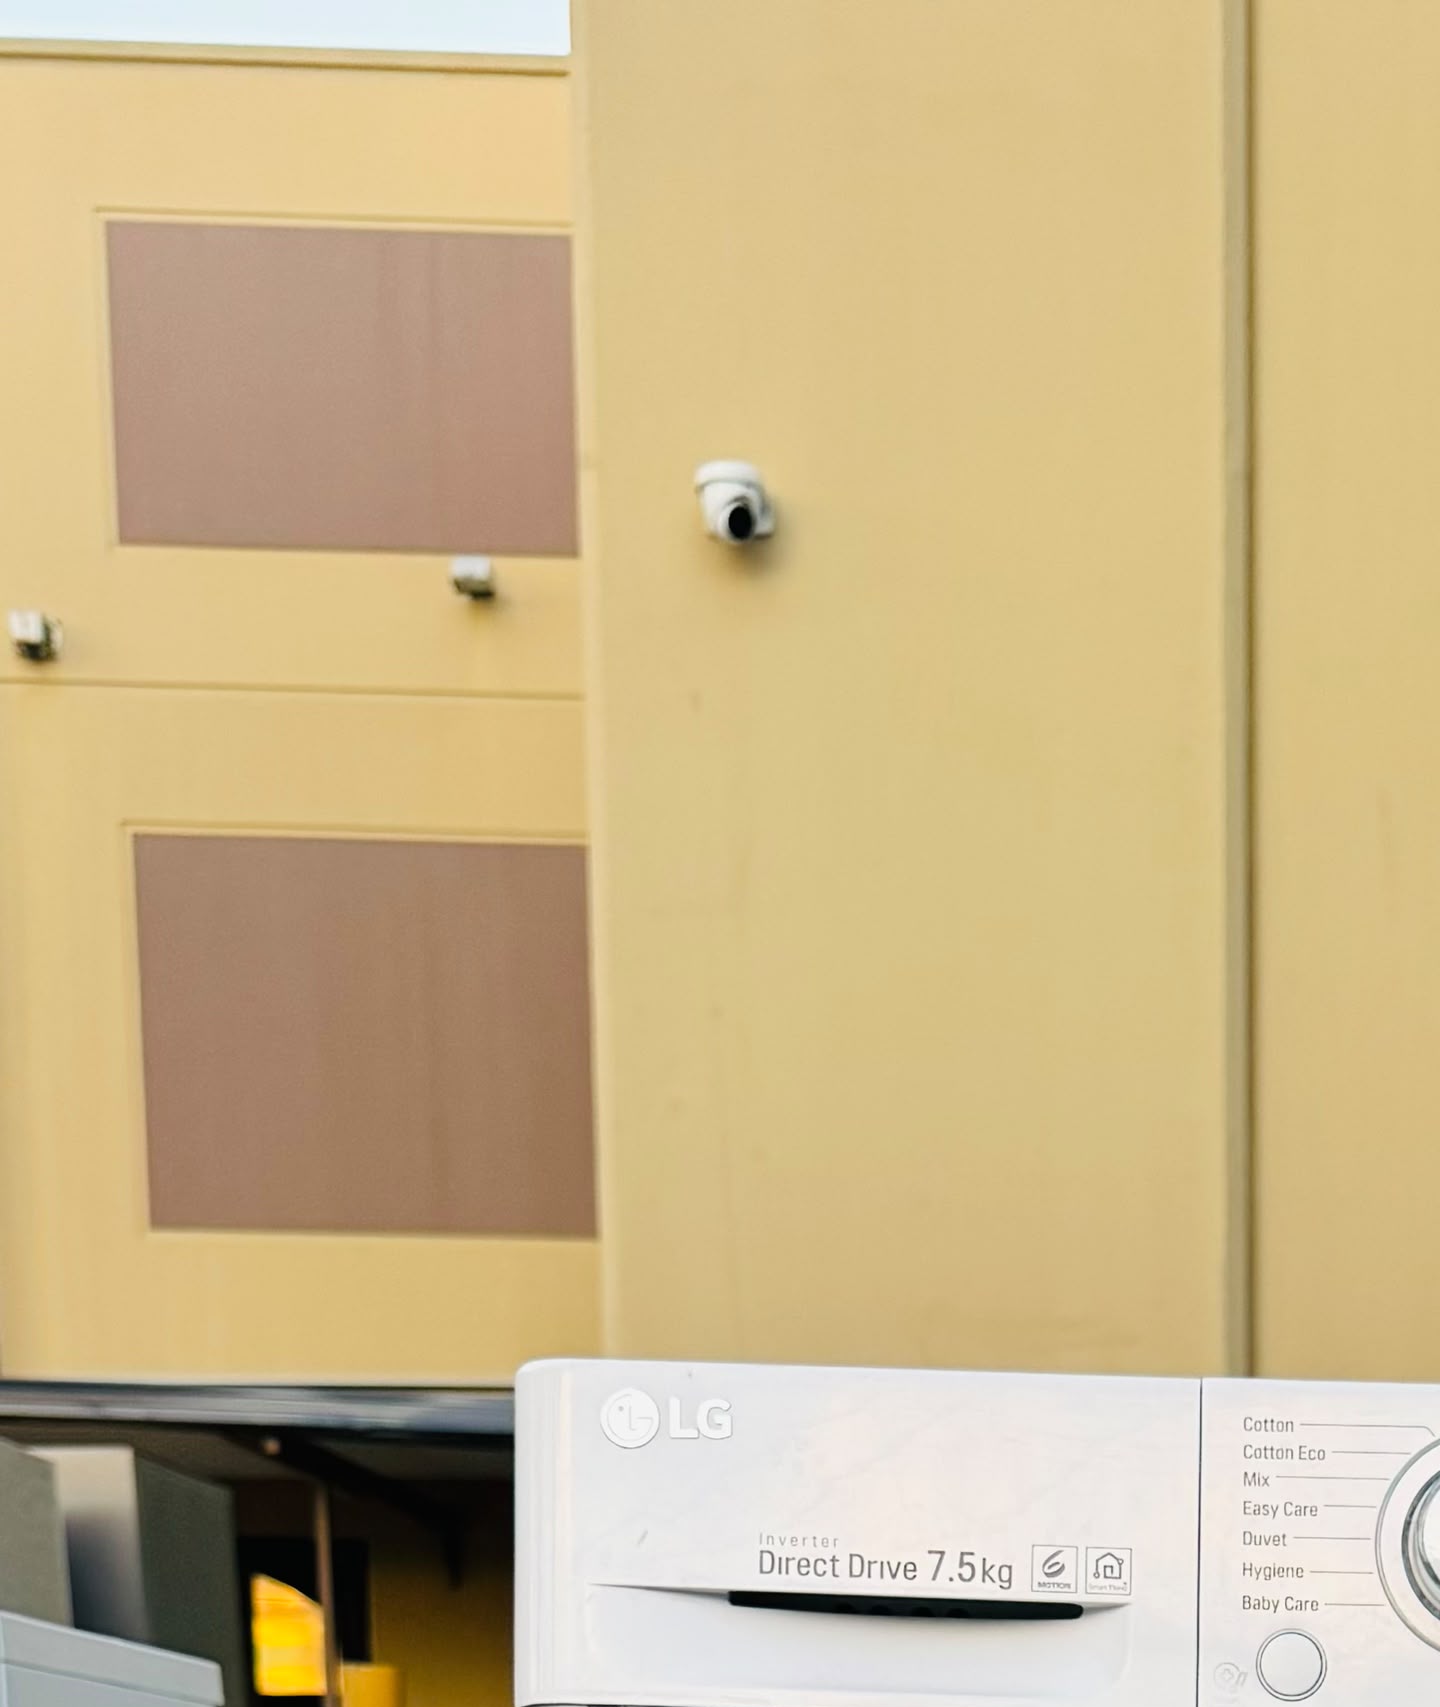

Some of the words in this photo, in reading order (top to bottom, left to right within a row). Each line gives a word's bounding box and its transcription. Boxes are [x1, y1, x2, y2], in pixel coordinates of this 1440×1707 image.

[668, 1396, 733, 1440] LG
[1243, 1416, 1294, 1433] Cotton
[1243, 1444, 1294, 1460] Cotton
[1298, 1445, 1326, 1461] Eco
[1243, 1471, 1270, 1487] Mix
[1243, 1500, 1279, 1520] Easy
[1283, 1501, 1318, 1517] Care
[759, 1532, 839, 1548] Inverter
[1243, 1531, 1287, 1547] Duvet
[758, 1550, 840, 1579] Direct
[848, 1554, 918, 1581] Drive
[927, 1550, 1013, 1590] 7.5kg
[1242, 1561, 1304, 1581] Hygiene
[1242, 1595, 1279, 1614] Baby
[1284, 1596, 1319, 1612] Care
